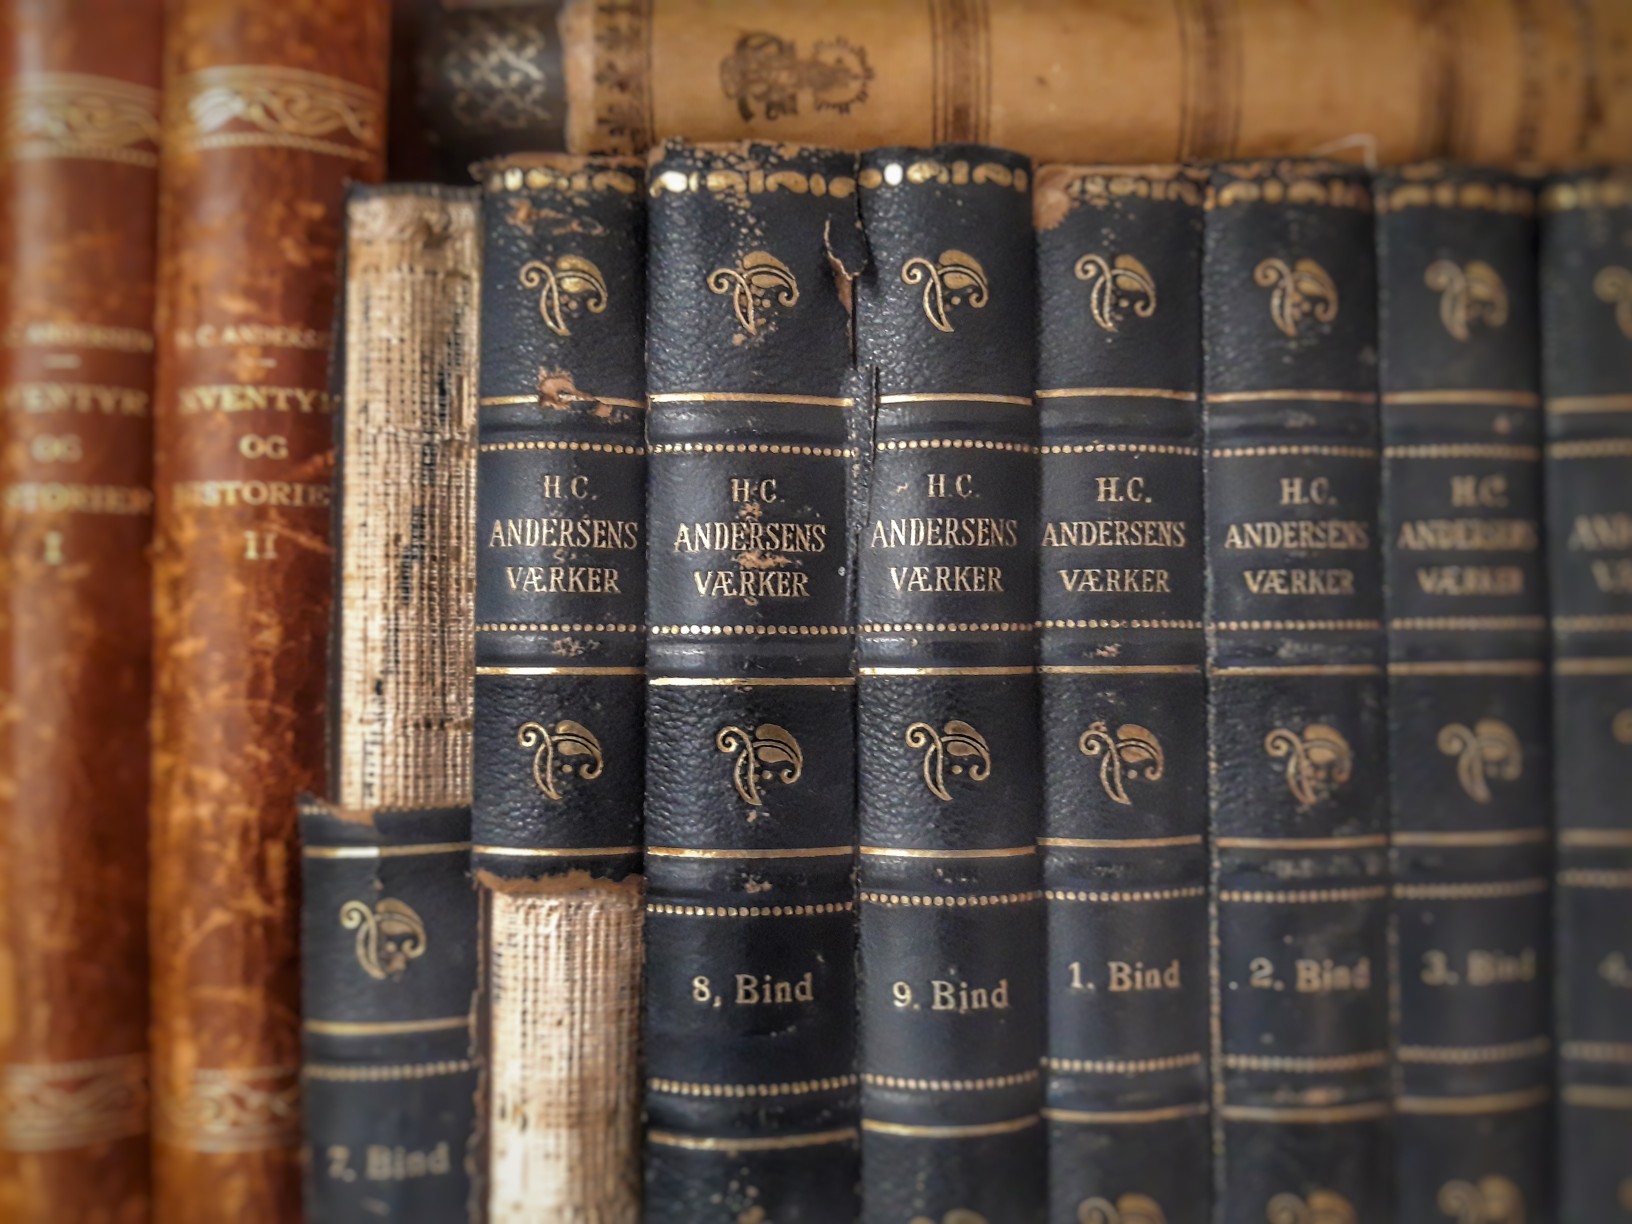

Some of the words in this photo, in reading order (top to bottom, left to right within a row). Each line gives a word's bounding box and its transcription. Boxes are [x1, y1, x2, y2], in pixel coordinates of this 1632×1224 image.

[239, 433, 288, 460] OG
[489, 518, 638, 550] ANDERSENS
[674, 521, 827, 552] ANDERSENS
[871, 517, 1018, 548] ANDERSENS
[1042, 520, 1187, 548] ANDERSENS
[1224, 519, 1370, 549] ANDERSENS
[505, 566, 622, 594] VÆRKER
[693, 570, 810, 597] VÆRKER
[888, 566, 1004, 592] VÆRKER
[1058, 568, 1171, 593] VÆRKER
[1243, 568, 1355, 595] VÆRKER
[735, 972, 815, 1004] Bind
[1068, 961, 1096, 990] 1.
[1107, 958, 1181, 992] Bind
[1249, 956, 1286, 992] 2.
[1295, 955, 1371, 993] Bind
[892, 981, 921, 1011] 9.
[931, 978, 1009, 1012] Bind
